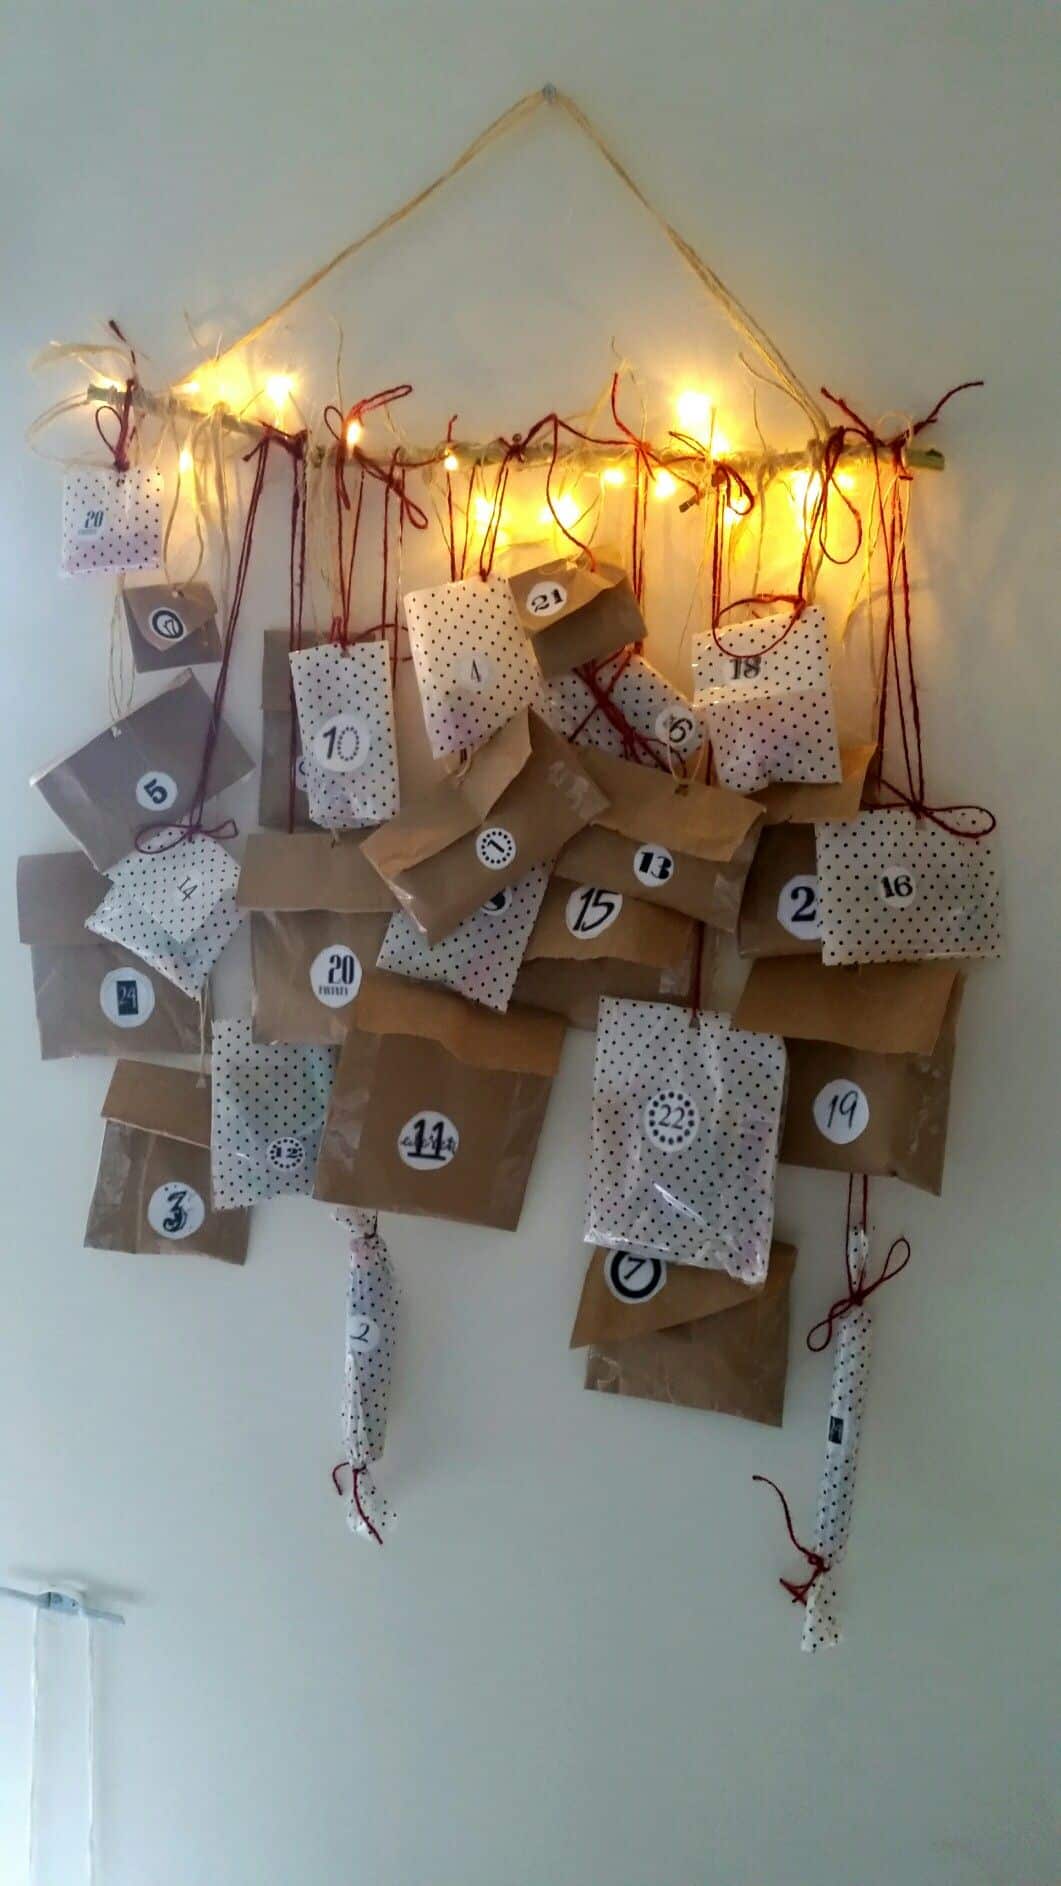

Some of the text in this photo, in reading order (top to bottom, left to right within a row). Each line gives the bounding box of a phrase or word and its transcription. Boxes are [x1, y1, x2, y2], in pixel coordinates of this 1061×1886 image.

[84, 511, 104, 529] 20
[530, 588, 564, 613] 21
[728, 657, 762, 680] 18
[322, 726, 360, 762] 10
[143, 778, 168, 804] 5
[487, 838, 506, 854] 1
[640, 851, 672, 880] 13
[176, 875, 199, 902] 14
[880, 874, 913, 898] 16
[573, 887, 621, 933] 15
[790, 886, 817, 922] 2
[328, 954, 355, 985] 20
[118, 986, 137, 1008] 24
[657, 1103, 686, 1130] 22
[827, 1089, 859, 1129] 19
[409, 1119, 446, 1160] 11
[275, 1147, 298, 1159] 12
[162, 1190, 188, 1233] 3
[624, 1256, 647, 1281] 7
[350, 1322, 370, 1343] 2
